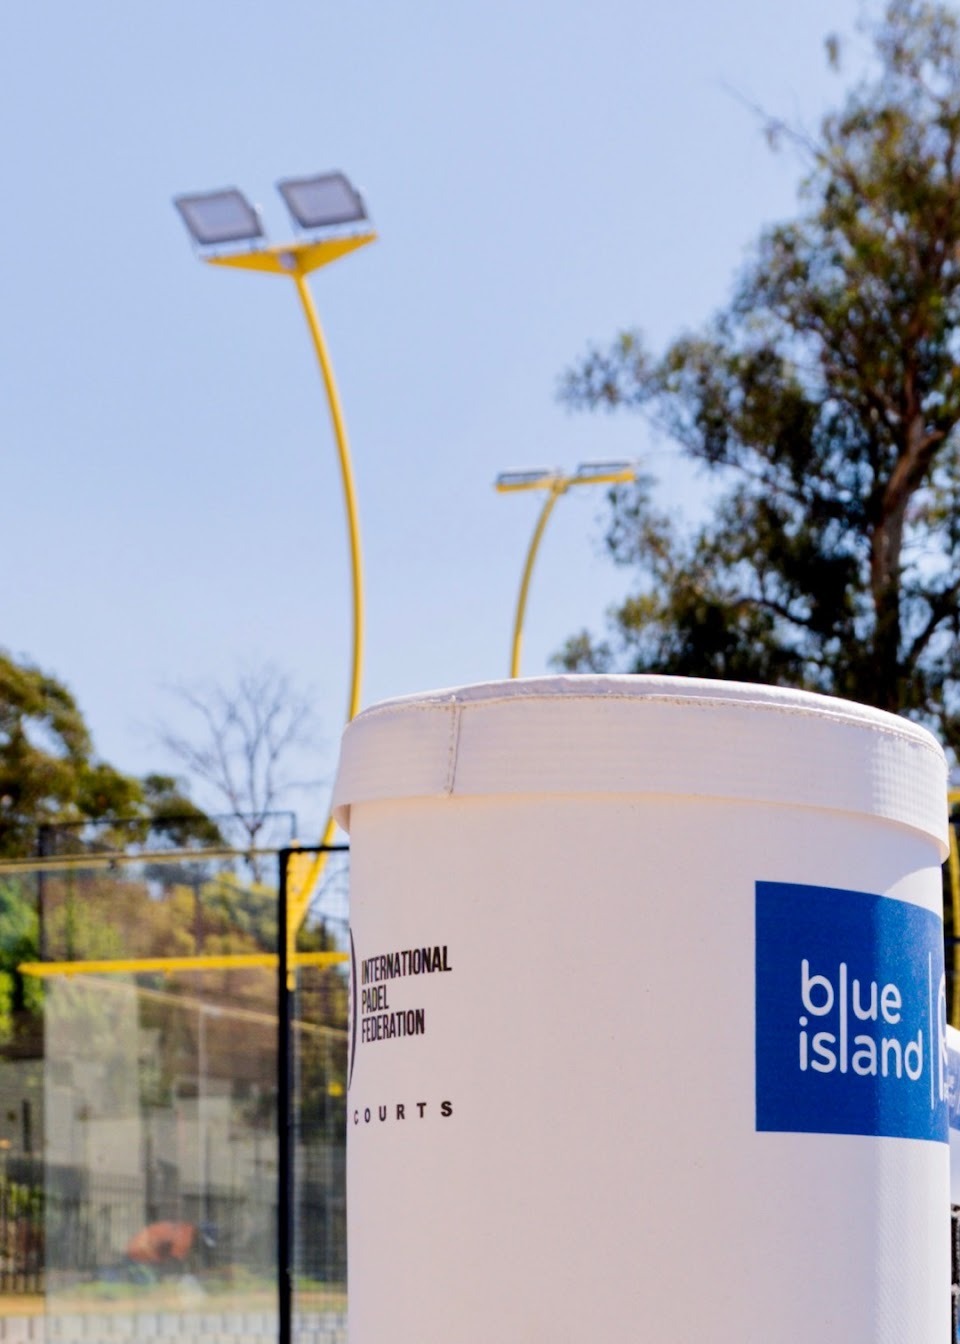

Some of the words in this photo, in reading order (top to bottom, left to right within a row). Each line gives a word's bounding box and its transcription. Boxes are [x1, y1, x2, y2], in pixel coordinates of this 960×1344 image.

[361, 945, 453, 986] INTERNATIONAL
[361, 984, 390, 1015] PADEL
[801, 958, 902, 1025] blue
[361, 1008, 425, 1044] FEDERATION
[798, 1015, 924, 1081] island
[353, 1100, 454, 1126] COURTS
